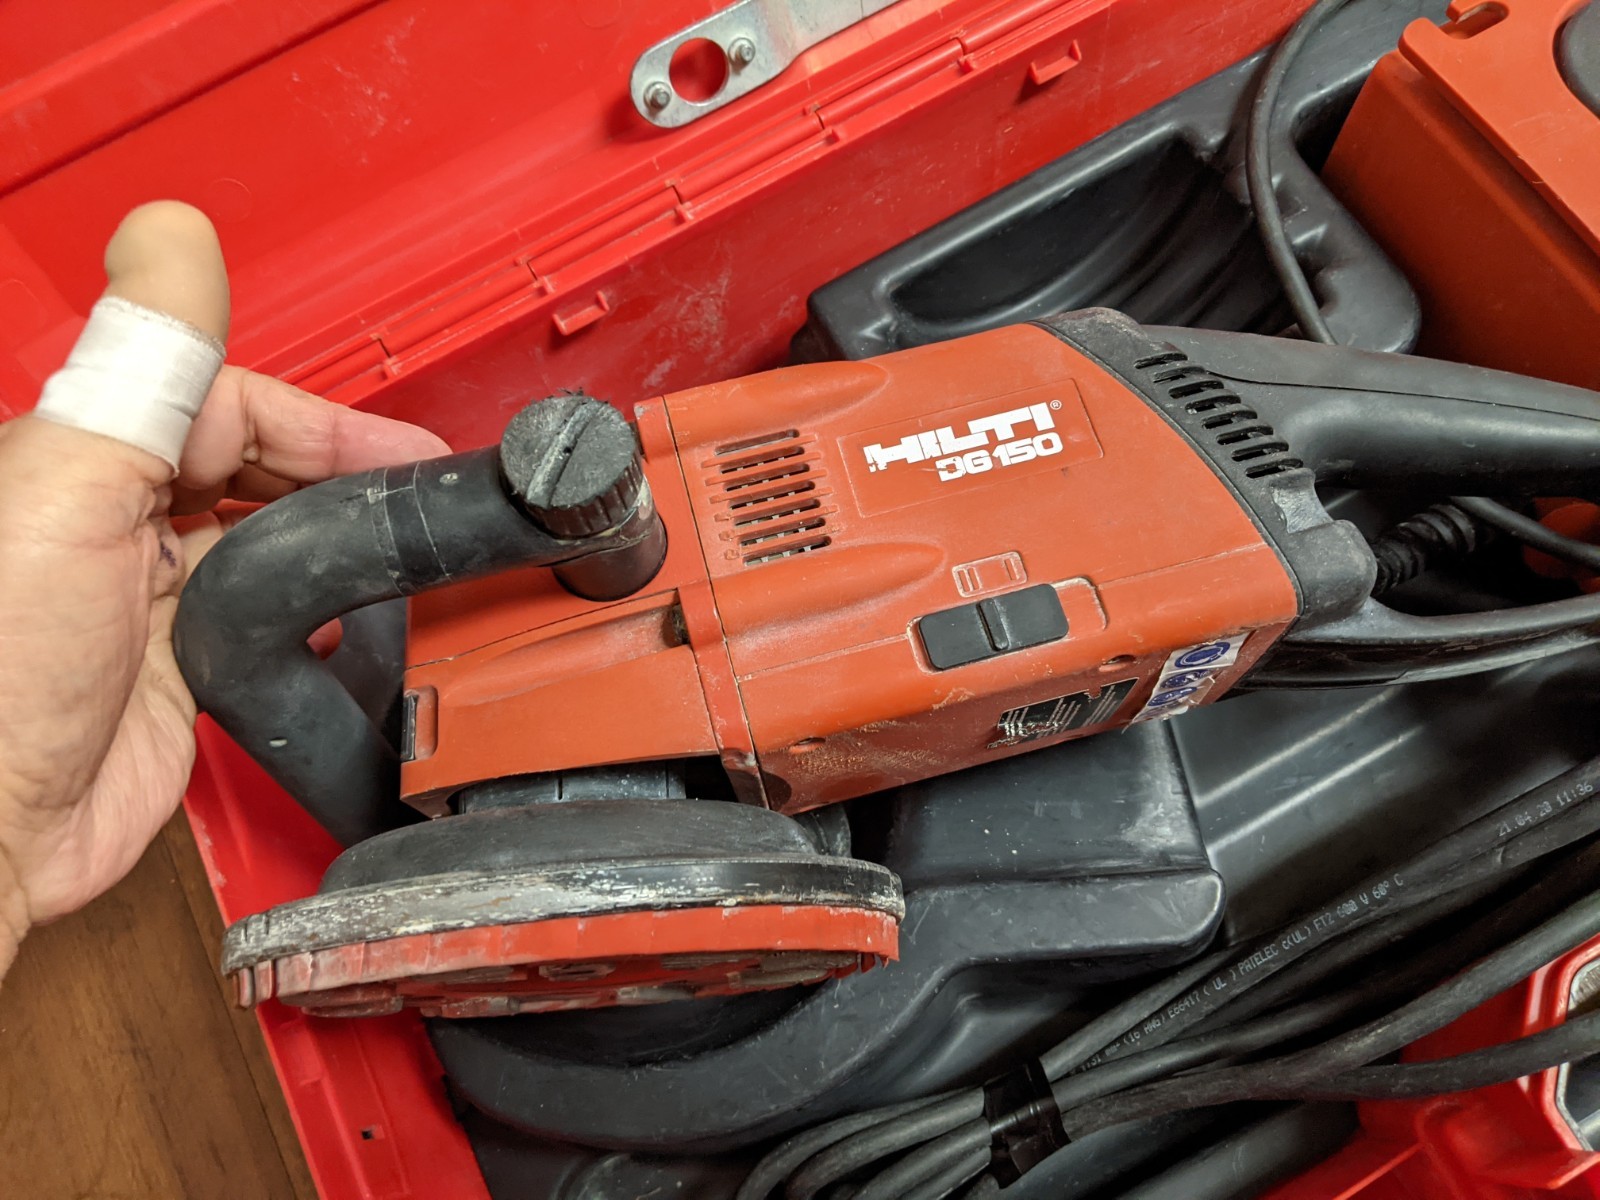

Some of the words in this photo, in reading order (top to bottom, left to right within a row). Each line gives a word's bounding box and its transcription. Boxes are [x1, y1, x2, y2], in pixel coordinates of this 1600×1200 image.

[1556, 782, 1593, 806] 11:36
[1237, 943, 1279, 976] PATELEC
[1336, 899, 1358, 918] 600
[1359, 893, 1369, 905] V
